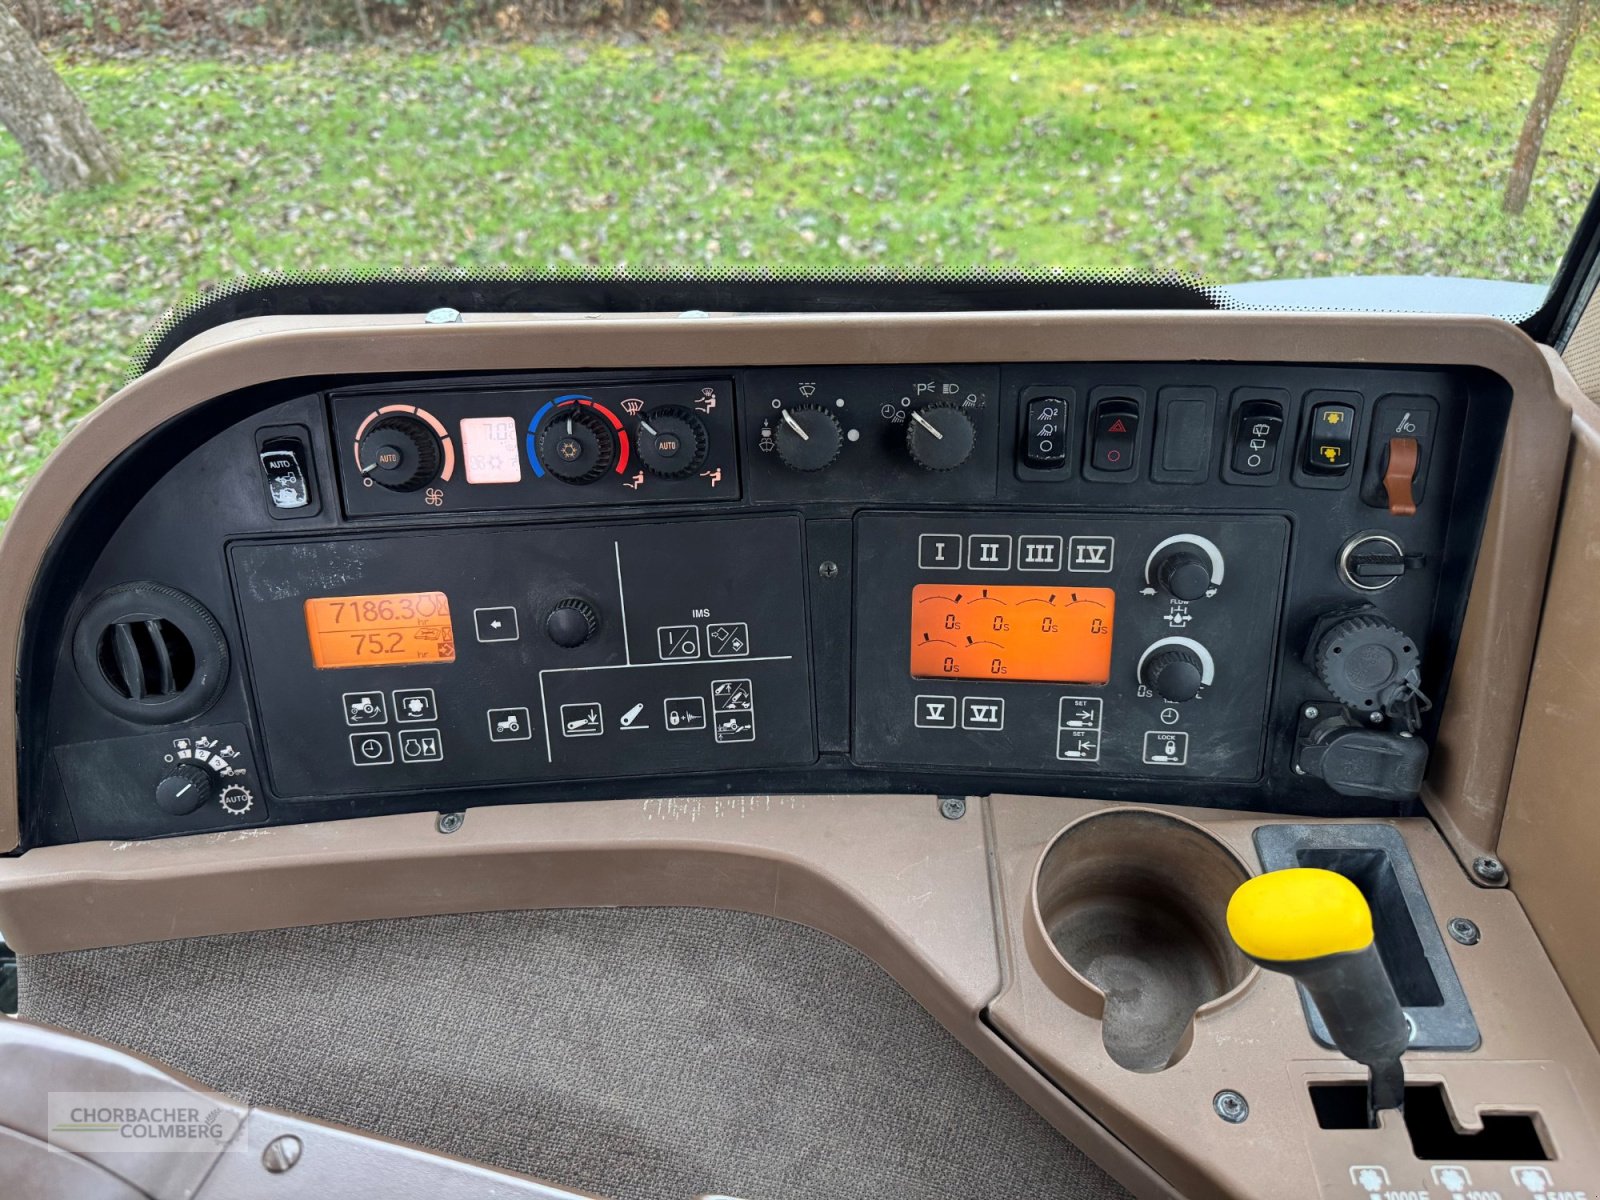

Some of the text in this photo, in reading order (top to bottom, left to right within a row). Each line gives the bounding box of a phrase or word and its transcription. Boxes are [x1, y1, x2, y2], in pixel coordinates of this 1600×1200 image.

[1053, 408, 1059, 416] 2
[659, 440, 676, 451] AUTO
[269, 459, 291, 469] AUTO
[379, 453, 397, 463] AUTO
[935, 543, 945, 561] I
[980, 543, 999, 562] II
[1025, 544, 1054, 563] III
[1075, 545, 1107, 564] IV
[329, 599, 415, 624] 7186.3
[692, 608, 711, 619] IMS
[417, 618, 430, 626] hr
[350, 632, 405, 655] 75.2
[417, 650, 429, 658] hr
[926, 703, 945, 721] V
[970, 705, 998, 722] VI
[225, 794, 248, 804] AUTO
